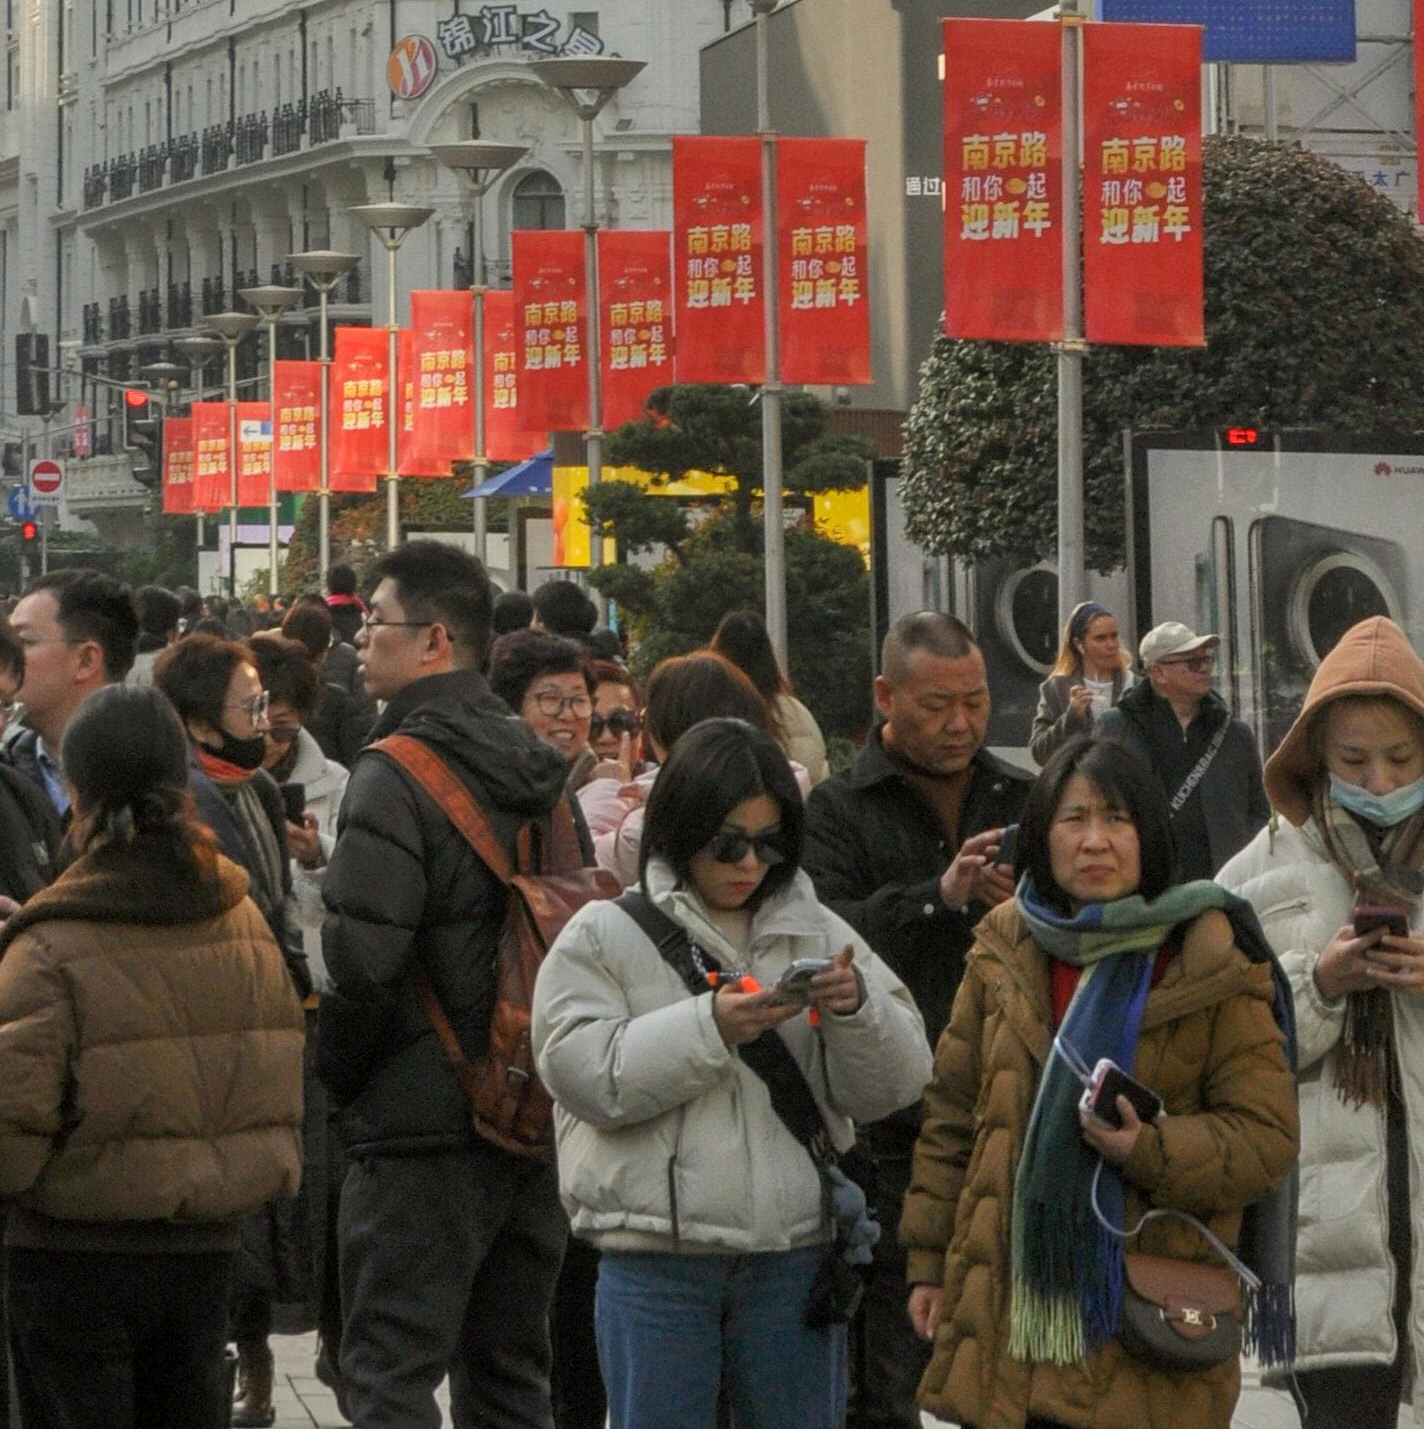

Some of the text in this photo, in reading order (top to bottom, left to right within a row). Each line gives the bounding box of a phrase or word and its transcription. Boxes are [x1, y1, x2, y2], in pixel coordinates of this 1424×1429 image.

[962, 131, 1047, 171] 南京路
[1102, 135, 1186, 175] 南京路
[960, 200, 1051, 241] 迎新年
[1100, 204, 1191, 245] 迎新年
[687, 223, 752, 255] 南京路
[792, 225, 856, 256] 南京路
[687, 277, 756, 308] 迎新年
[791, 278, 860, 309] 迎新年
[525, 300, 577, 326] 南京路
[610, 300, 662, 326] 南京路
[525, 344, 581, 369] 迎新年
[610, 344, 667, 369] 迎新年
